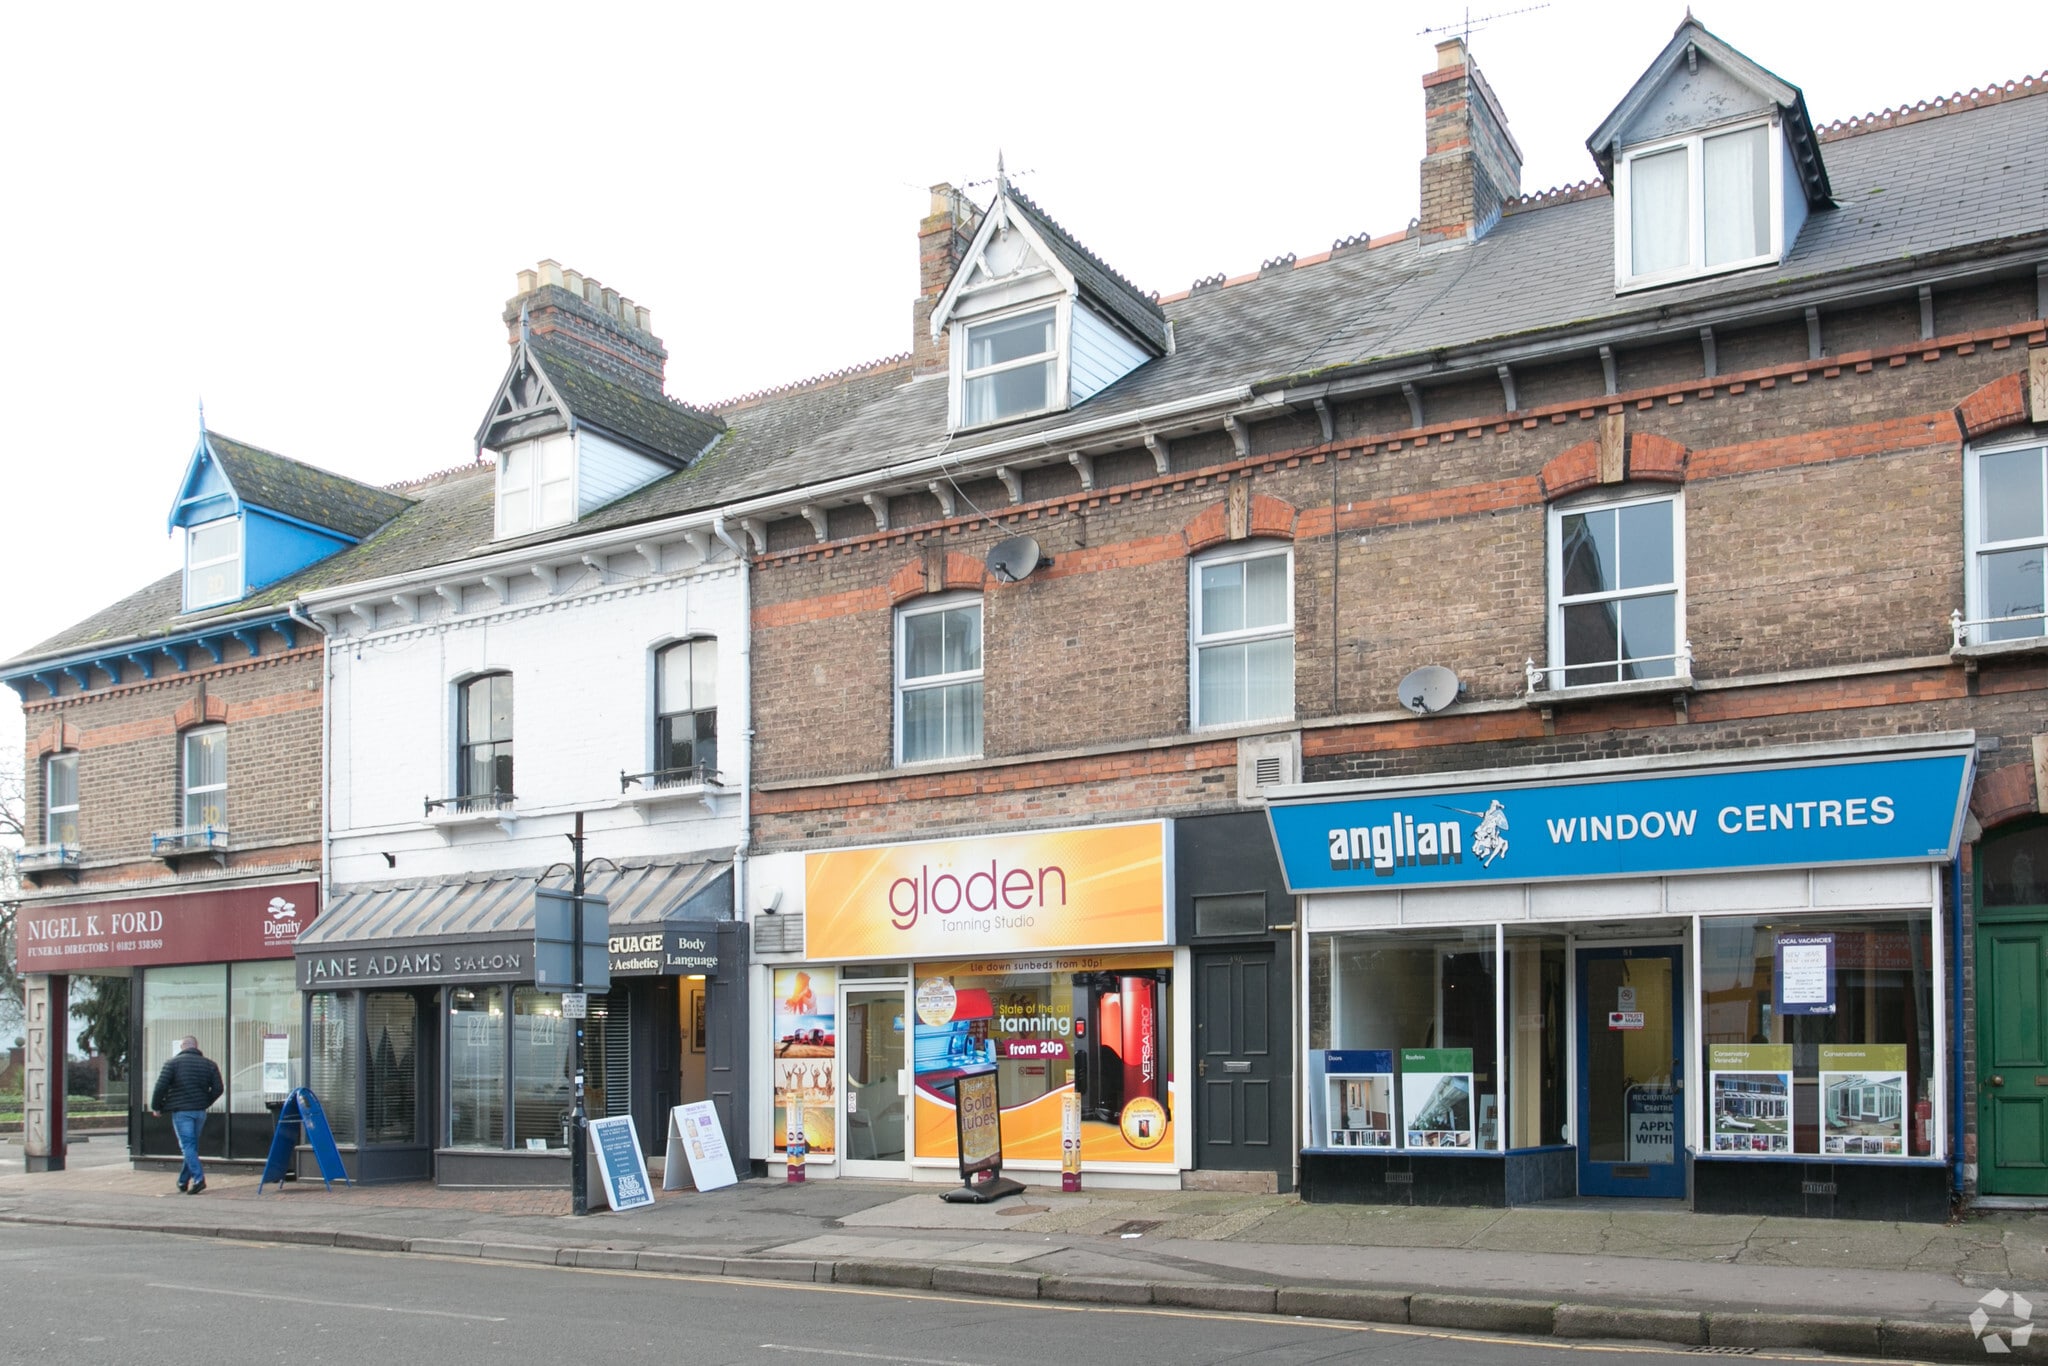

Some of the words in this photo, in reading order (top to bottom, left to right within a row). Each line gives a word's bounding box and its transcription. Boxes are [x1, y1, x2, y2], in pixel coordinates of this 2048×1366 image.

[1547, 810, 1697, 843] WINDOW
[1718, 796, 1895, 834] CENTRES
[1328, 812, 1462, 872] anglian
[28, 917, 81, 940] NIGEL
[86, 915, 105, 936] K.
[111, 910, 163, 934] FORD
[264, 920, 300, 938] Dignity
[942, 918, 991, 932] Tanning
[995, 914, 1035, 928] Studio
[27, 946, 63, 957] FUNERAL
[64, 942, 109, 955] DIRECTORS
[608, 934, 664, 953] GUAGE
[678, 937, 706, 952] Body
[305, 957, 358, 984] JANE
[366, 953, 442, 975] ADAMS
[615, 958, 659, 971] Aesthetics
[666, 953, 718, 968] Language
[970, 963, 984, 972] Lie
[986, 962, 1011, 971] down
[1014, 961, 1053, 970] sunbeds
[1056, 960, 1078, 969] from
[999, 1004, 1024, 1014] State
[1026, 1004, 1036, 1013] of
[1038, 1004, 1053, 1013] the
[1056, 1004, 1071, 1013] art
[999, 1014, 1071, 1036] tanning
[1009, 1043, 1037, 1055] from
[1040, 1042, 1064, 1055] 20p
[1714, 1050, 1750, 1058] Conservatory
[1823, 1050, 1867, 1058] Conservatories
[963, 1093, 993, 1113] Gold
[962, 1112, 996, 1131] tubes
[1636, 1134, 1673, 1144] WITHI
